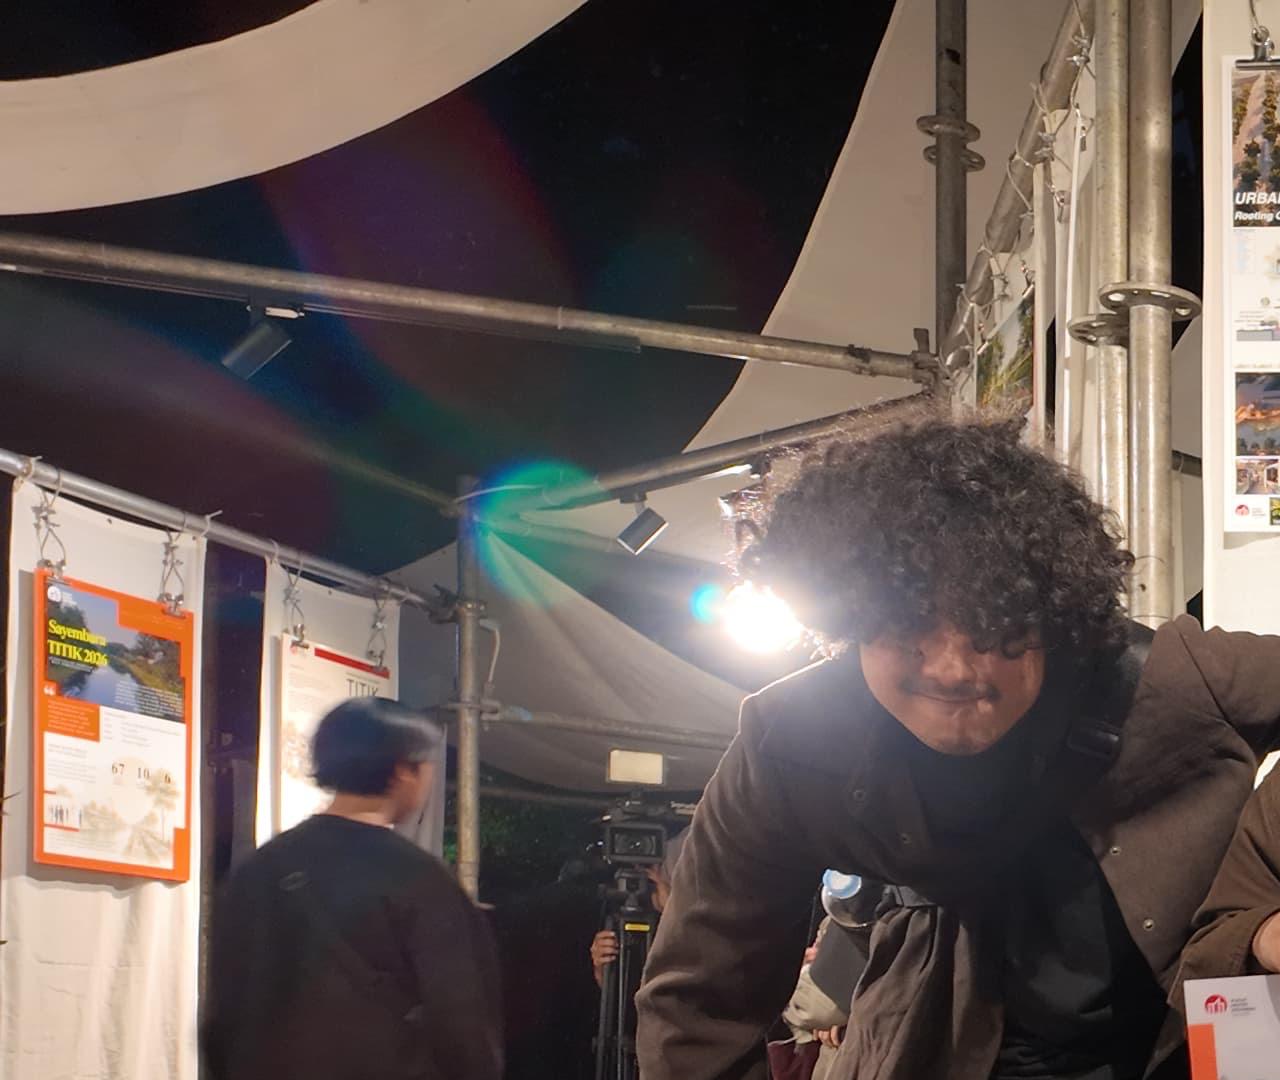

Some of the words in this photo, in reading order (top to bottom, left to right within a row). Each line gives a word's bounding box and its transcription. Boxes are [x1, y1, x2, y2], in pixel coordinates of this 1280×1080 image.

[1234, 210, 1274, 222] Rooting
[47, 639, 84, 662] TITIK
[111, 761, 125, 776] 67
